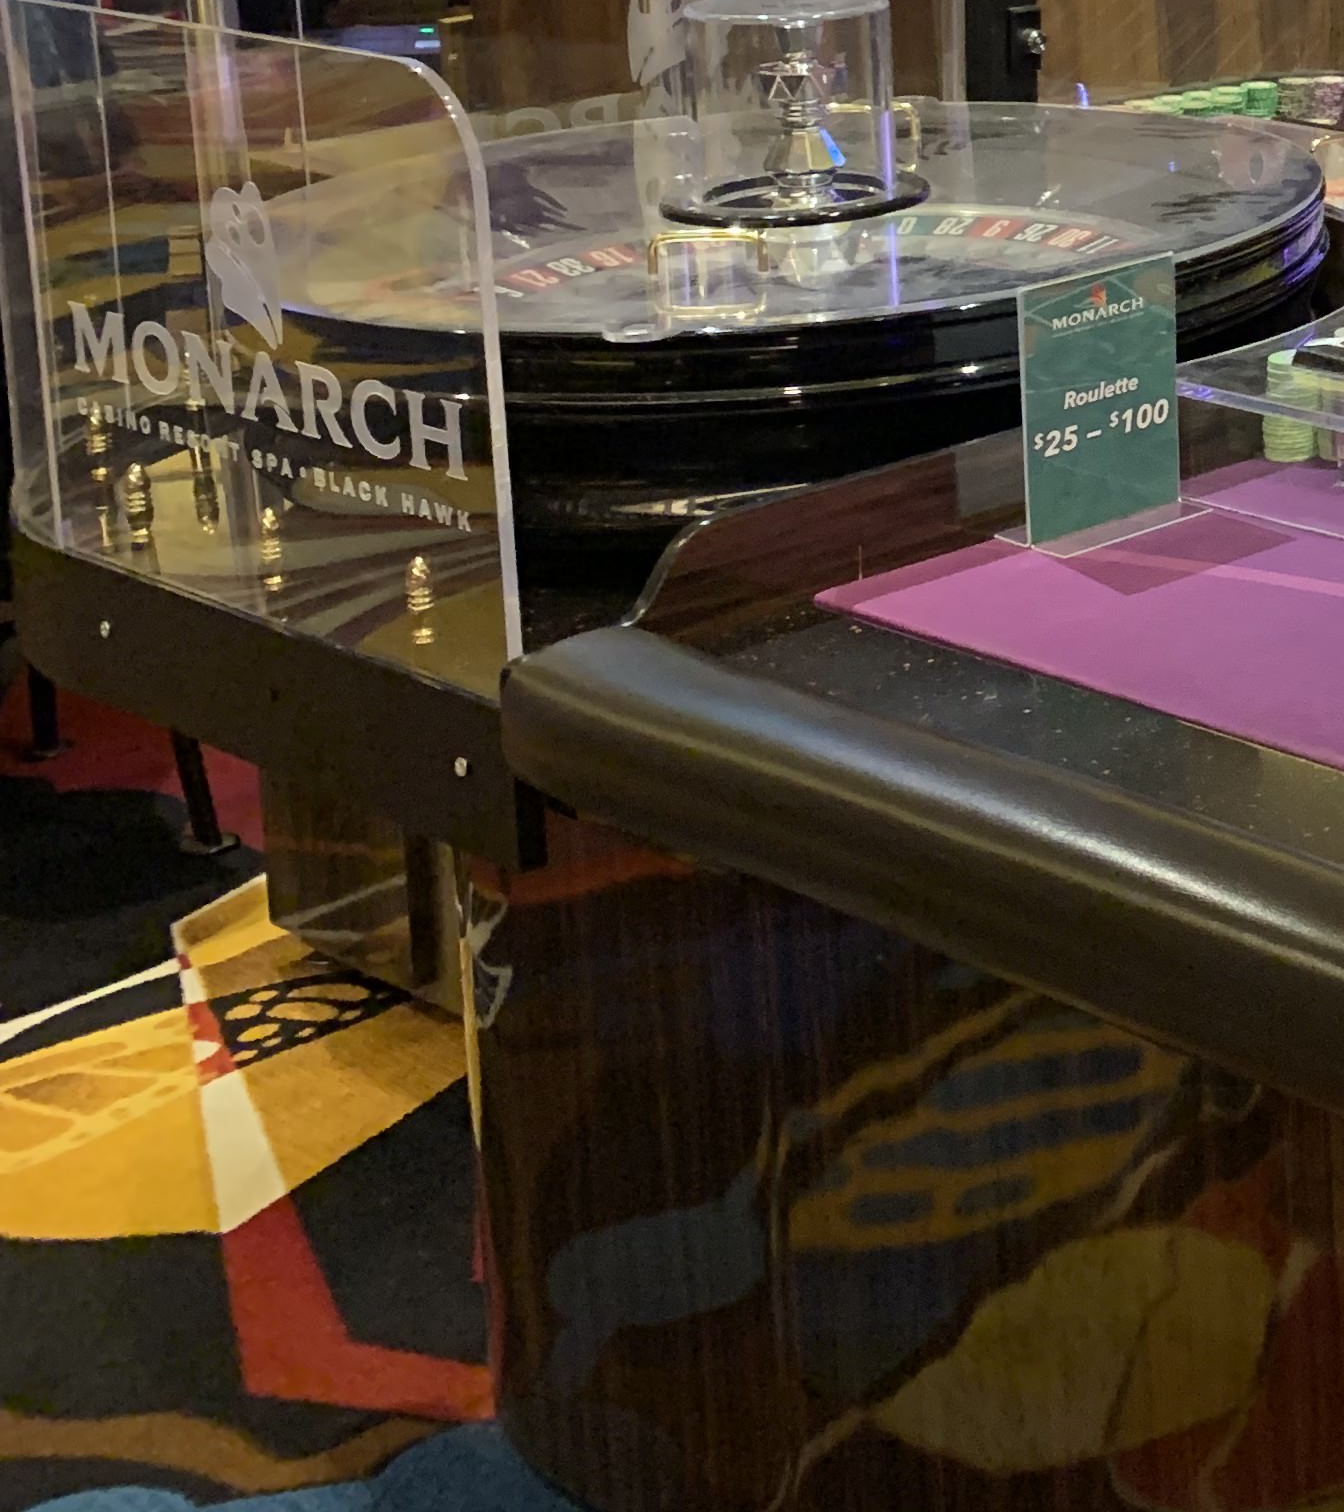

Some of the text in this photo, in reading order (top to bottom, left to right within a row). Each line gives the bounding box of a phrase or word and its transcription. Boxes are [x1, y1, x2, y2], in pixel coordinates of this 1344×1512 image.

[1051, 296, 1145, 331] MONARCH
[67, 300, 471, 481] MONARCH
[1063, 376, 1139, 410] Roulette
[1033, 398, 1170, 458] $25 $100
[77, 395, 473, 533] CASINO RESORT SPA BLACK HAWK
